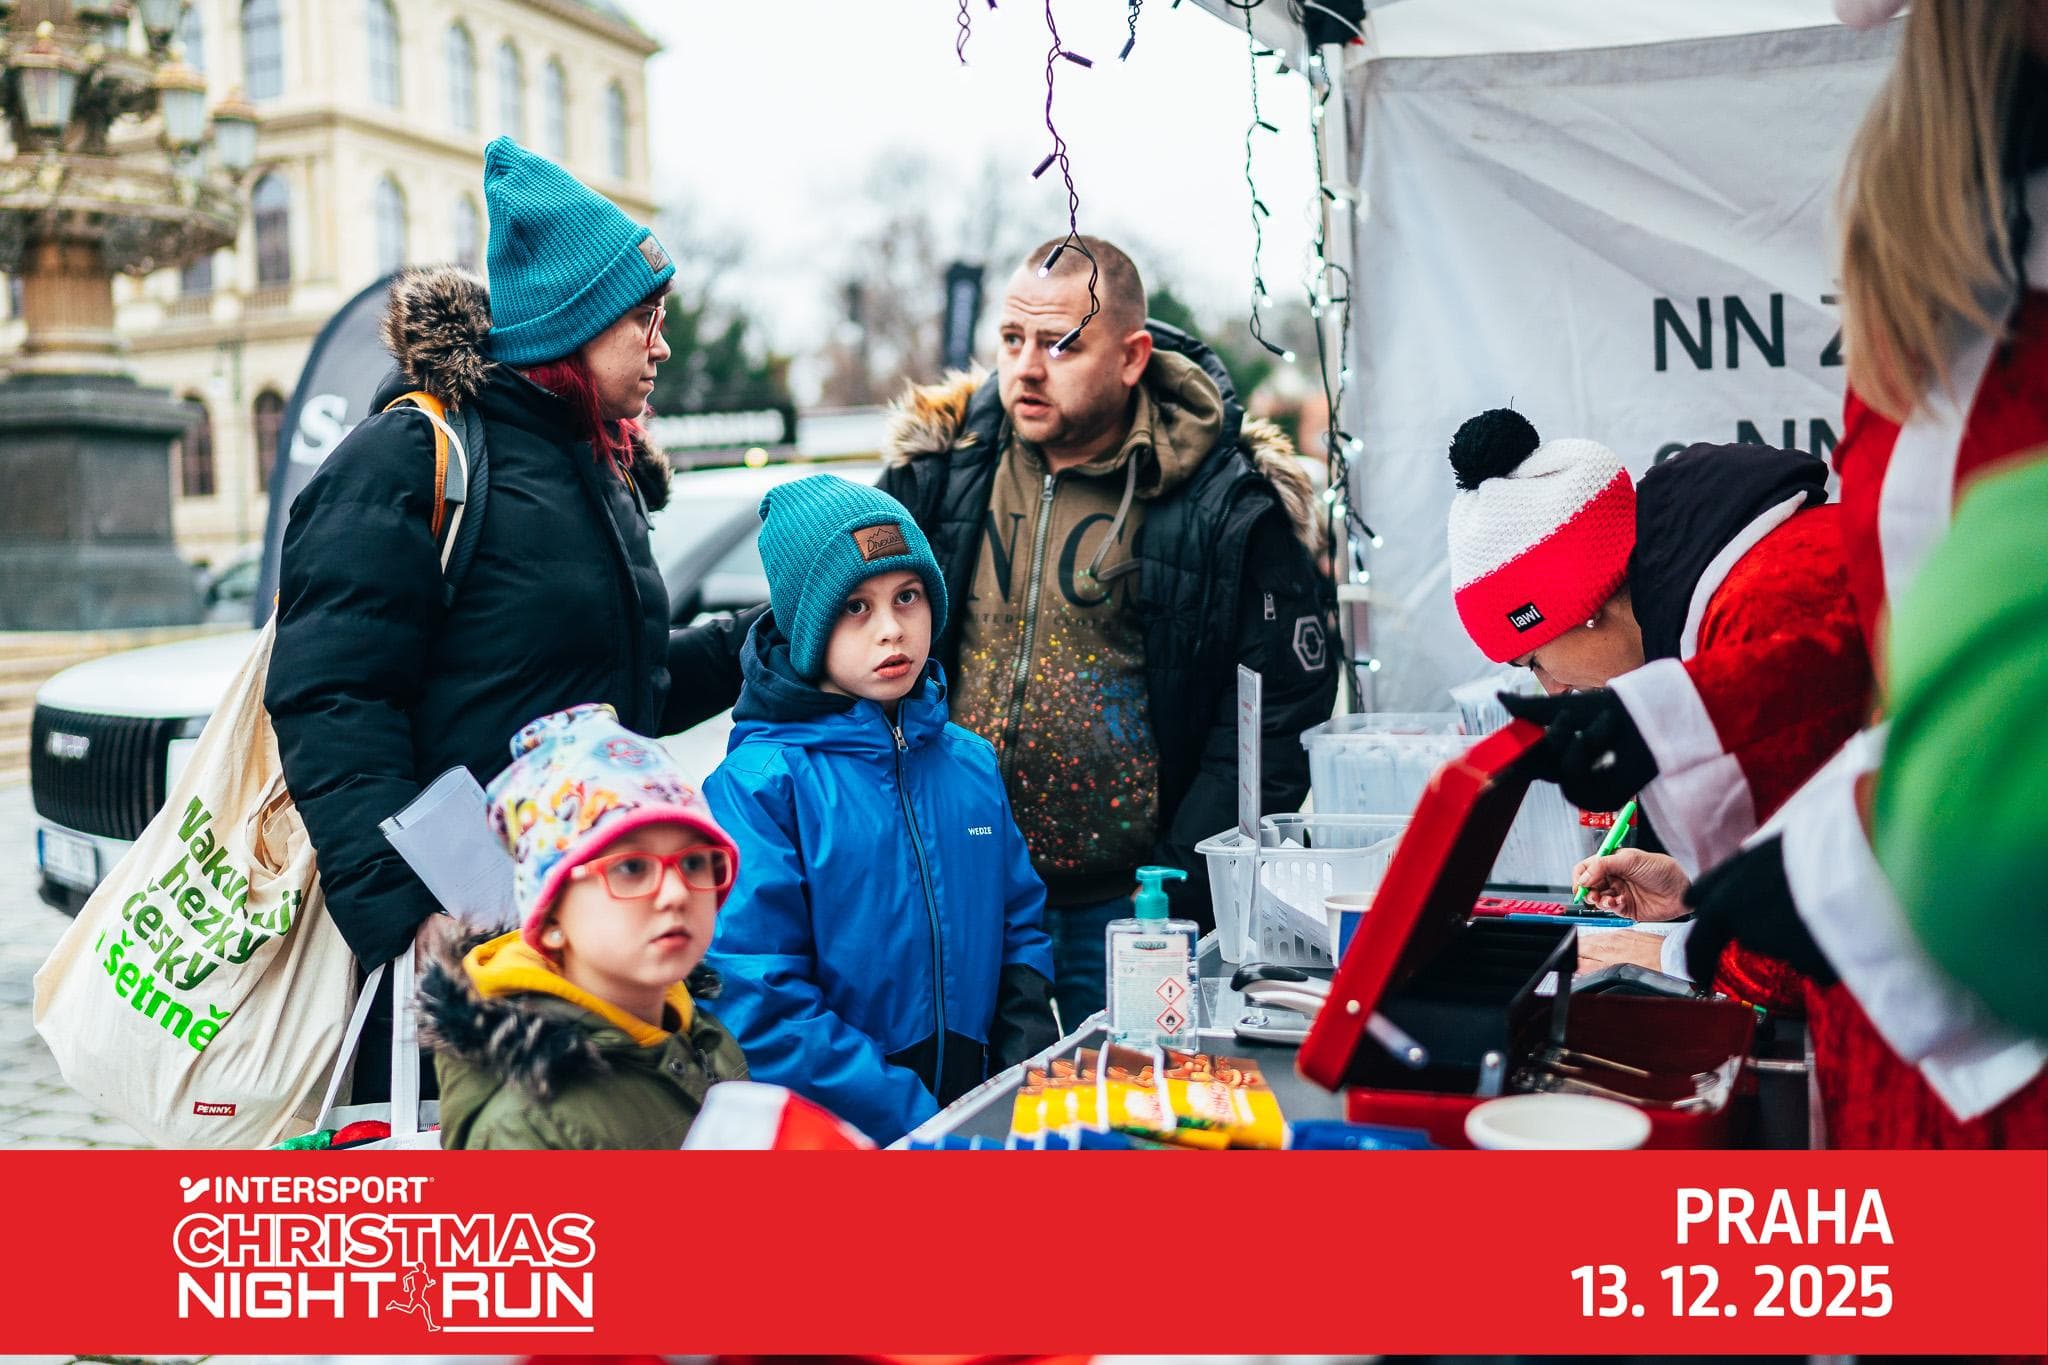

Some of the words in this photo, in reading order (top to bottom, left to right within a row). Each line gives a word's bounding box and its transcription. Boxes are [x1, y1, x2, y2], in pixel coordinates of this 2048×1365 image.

[1654, 292, 1786, 372] NN
[1510, 605, 1541, 628] lawi
[968, 826, 992, 836] WEDZE
[122, 877, 219, 991] česky
[159, 853, 271, 965] hezky
[103, 929, 231, 1053] šetrně
